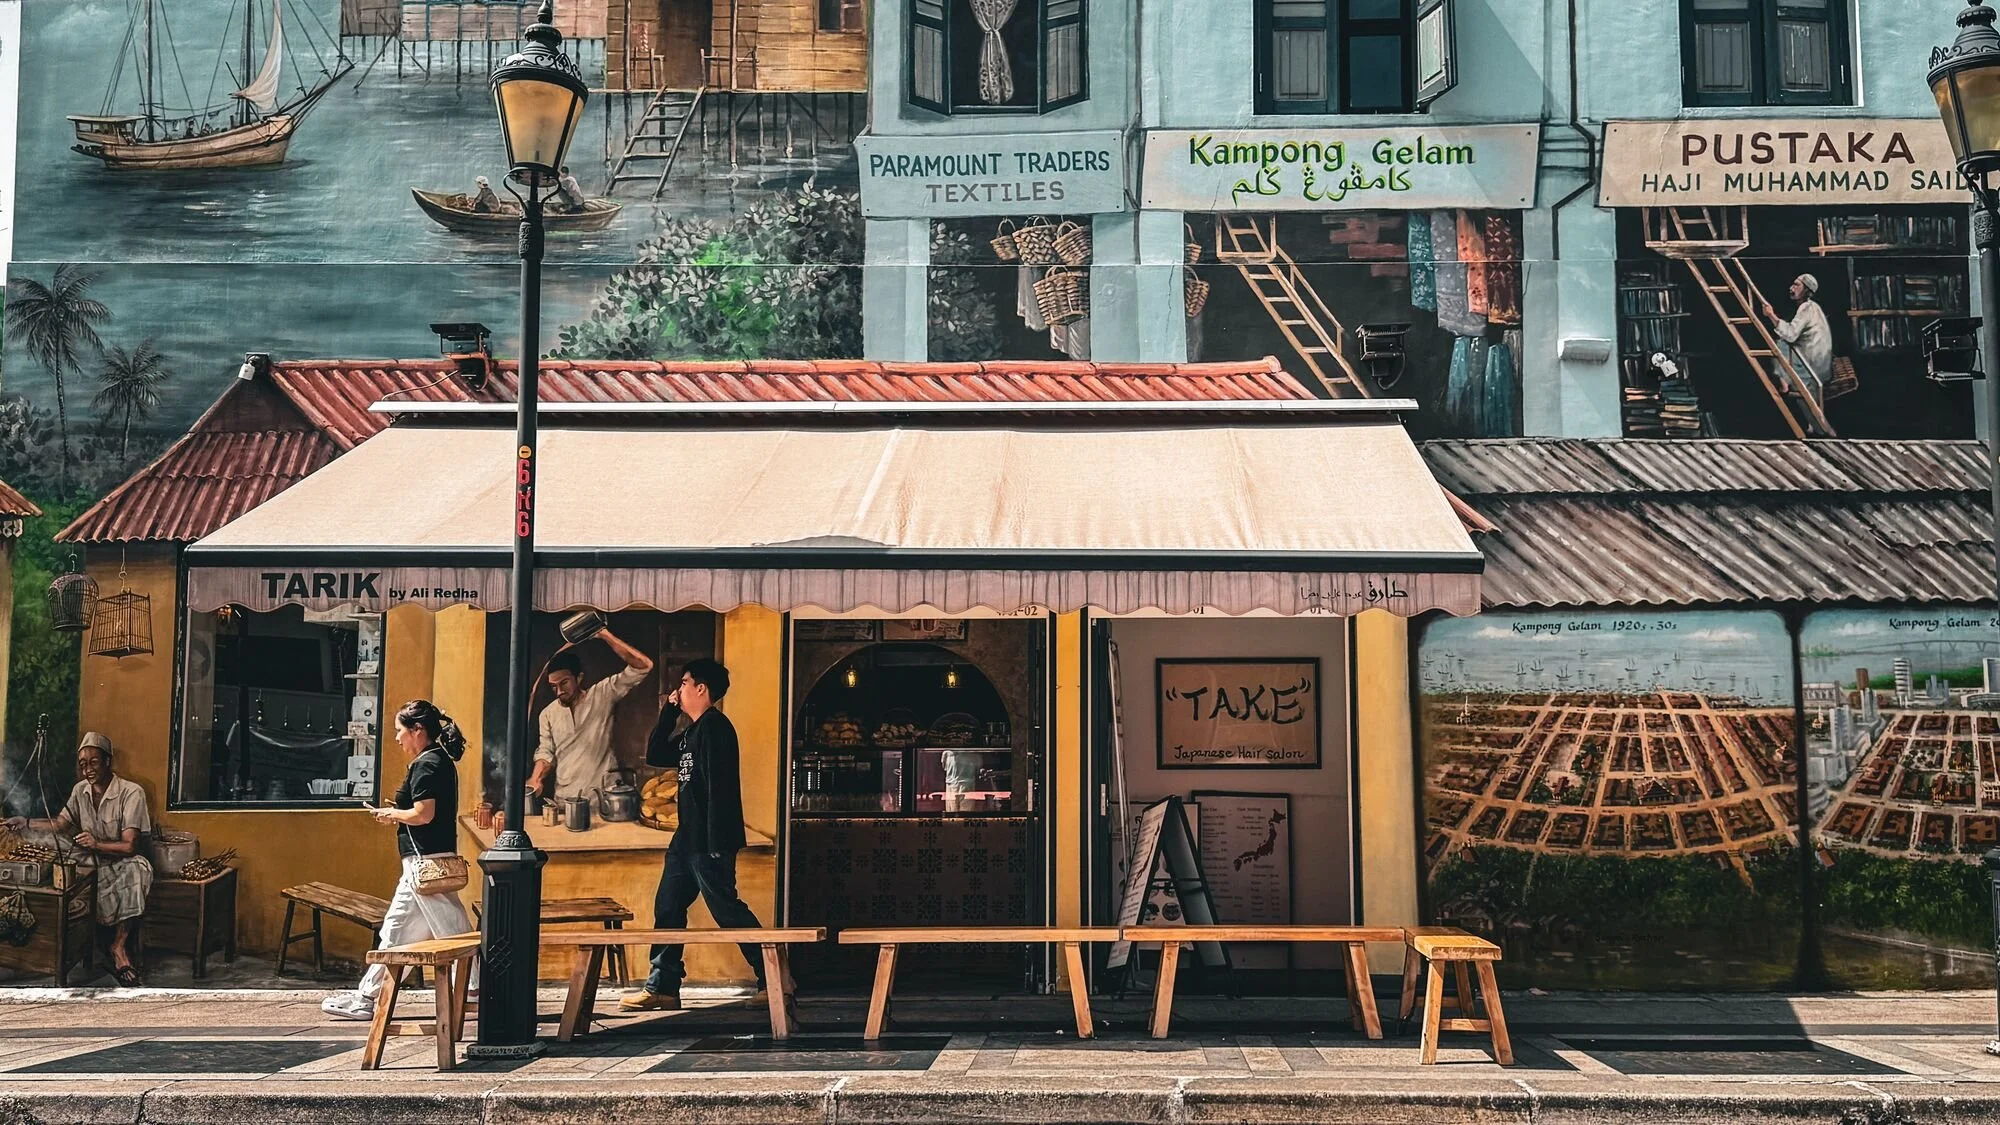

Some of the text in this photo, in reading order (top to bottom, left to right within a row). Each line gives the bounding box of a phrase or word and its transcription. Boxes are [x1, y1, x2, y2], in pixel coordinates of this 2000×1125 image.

[1189, 133, 1476, 172] Kampong Gelam
[1681, 131, 1915, 166] PUSTAKA
[870, 151, 1110, 177] PARAMOUNT TRADERS
[926, 180, 1065, 203] TEXTILES
[1641, 172, 1701, 193] HAJI
[1724, 171, 1890, 192] MUHAMMAD
[261, 572, 478, 599] TARIK by Ali Redha
[1512, 621, 1562, 634] Kampong
[1568, 621, 1602, 631] Gelam
[1612, 620, 1646, 632] 1920s
[1656, 620, 1678, 631] 30s
[1889, 618, 1940, 632] Kampong
[1947, 618, 1981, 628] Gelam
[1174, 745, 1234, 762] Japanese
[1237, 745, 1264, 759] Hair
